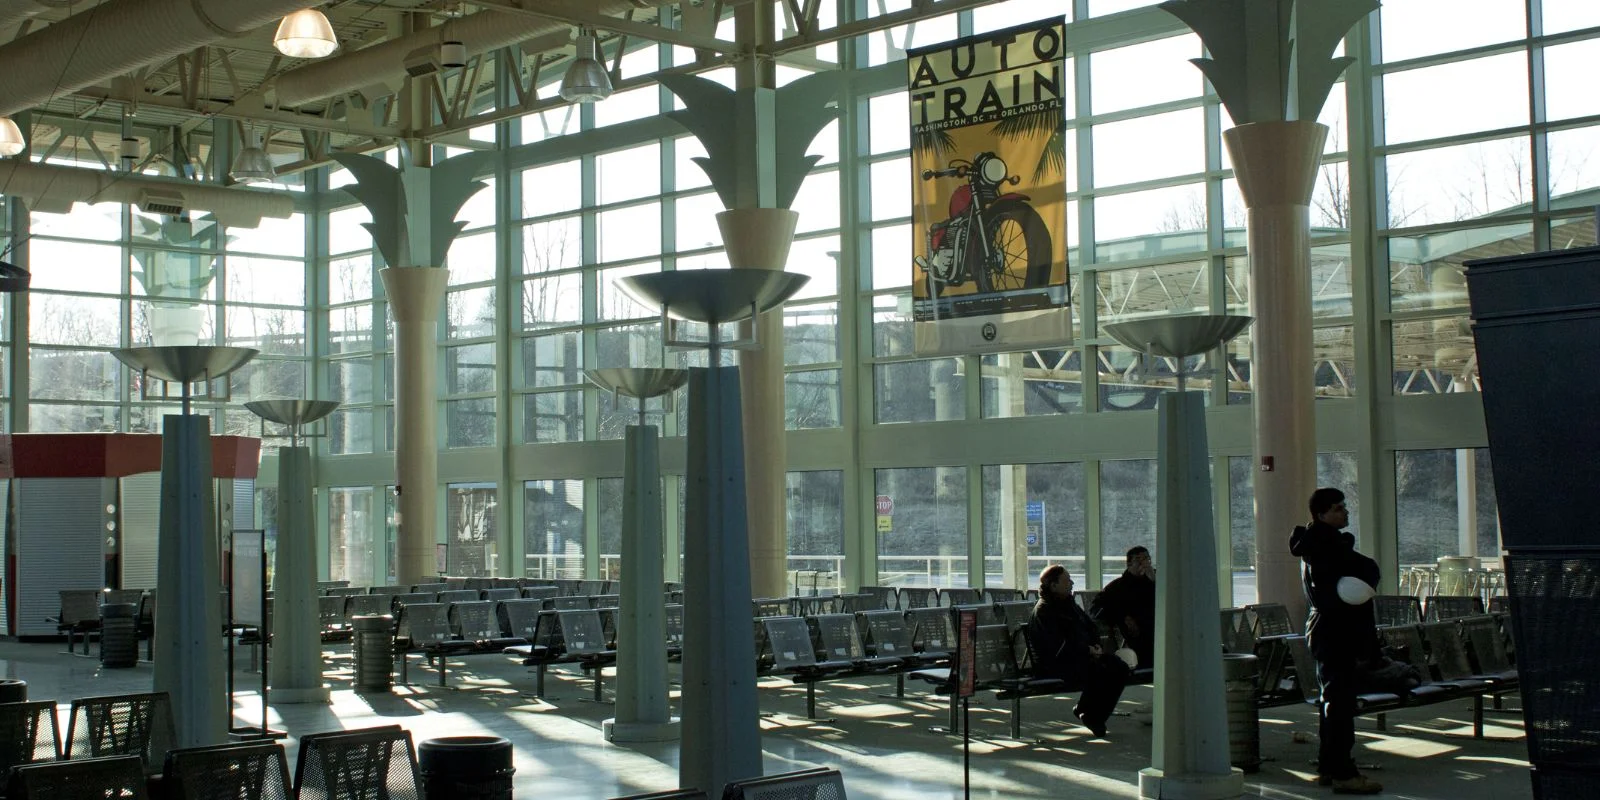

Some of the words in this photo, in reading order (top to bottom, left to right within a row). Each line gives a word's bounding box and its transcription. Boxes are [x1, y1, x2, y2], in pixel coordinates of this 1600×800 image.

[911, 28, 1060, 90] AUTO
[912, 66, 1060, 126] TRAIN
[972, 115, 984, 123] DC
[1049, 100, 1062, 109] FL
